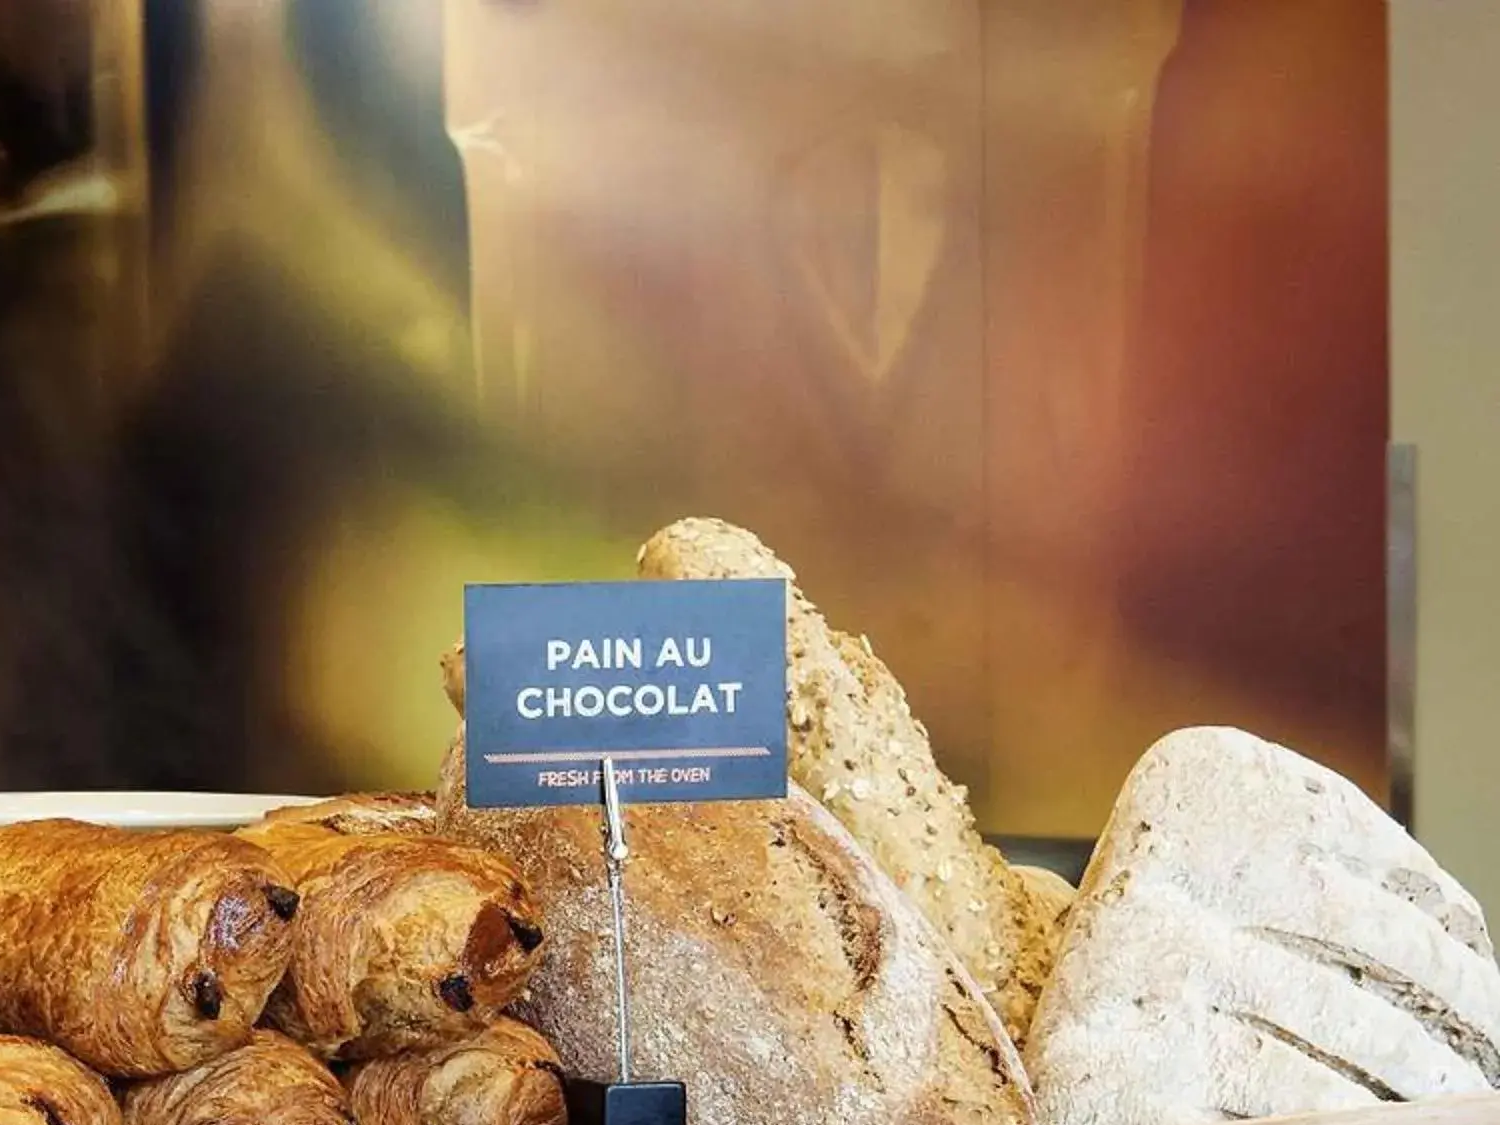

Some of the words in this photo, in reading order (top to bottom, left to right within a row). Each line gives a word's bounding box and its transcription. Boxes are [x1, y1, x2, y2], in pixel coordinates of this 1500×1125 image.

[547, 638, 642, 670] PAIN
[655, 637, 711, 668] AU
[516, 682, 743, 719] CHOCOLAT
[538, 769, 589, 787] FRESH
[592, 768, 634, 785] FOM
[638, 767, 669, 783] THE
[671, 767, 711, 783] OVEN
